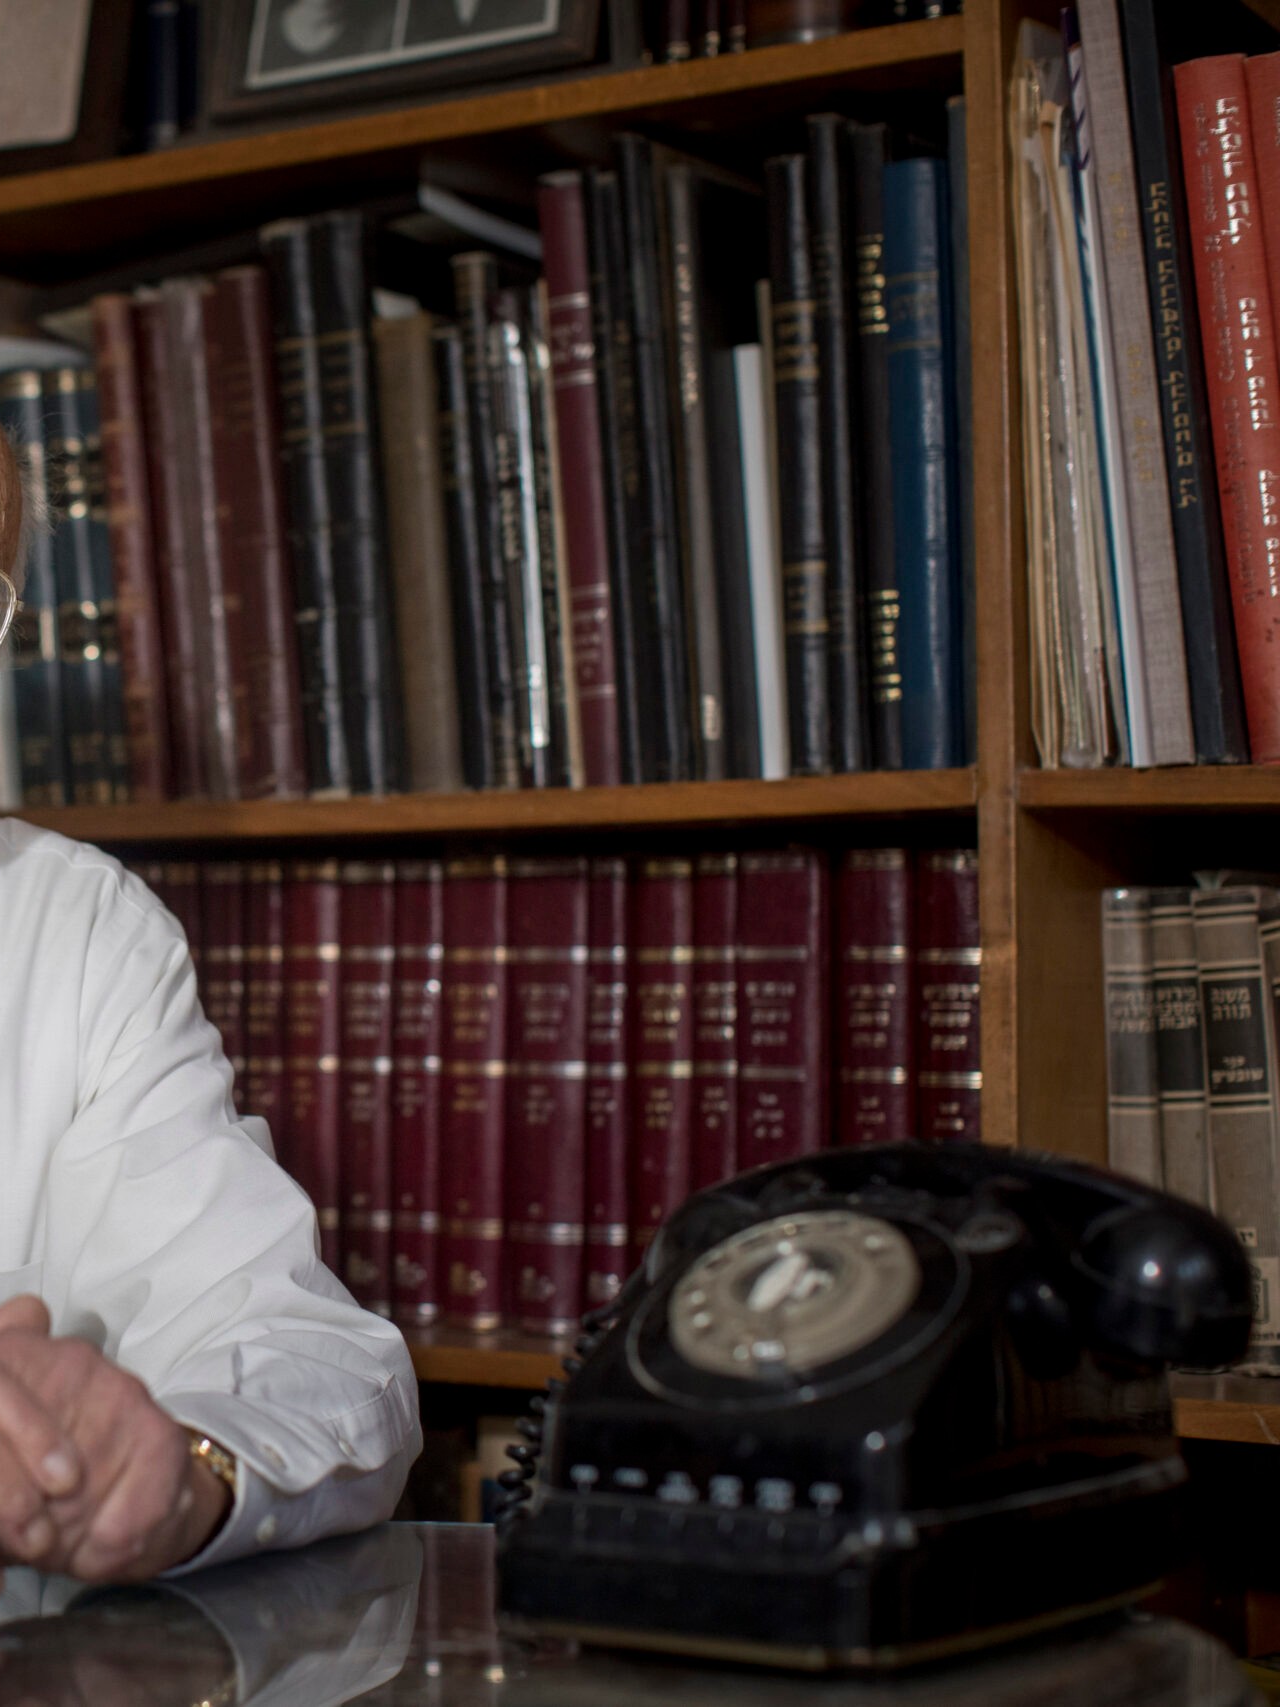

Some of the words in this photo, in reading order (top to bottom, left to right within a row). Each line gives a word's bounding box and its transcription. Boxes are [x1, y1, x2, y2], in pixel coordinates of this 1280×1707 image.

[1210, 97, 1244, 178] תלמוד
[1145, 182, 1171, 249] הלכות
[1219, 183, 1252, 245] בבלי
[1244, 348, 1263, 372] יד
[1212, 1004, 1251, 1021] תורה
